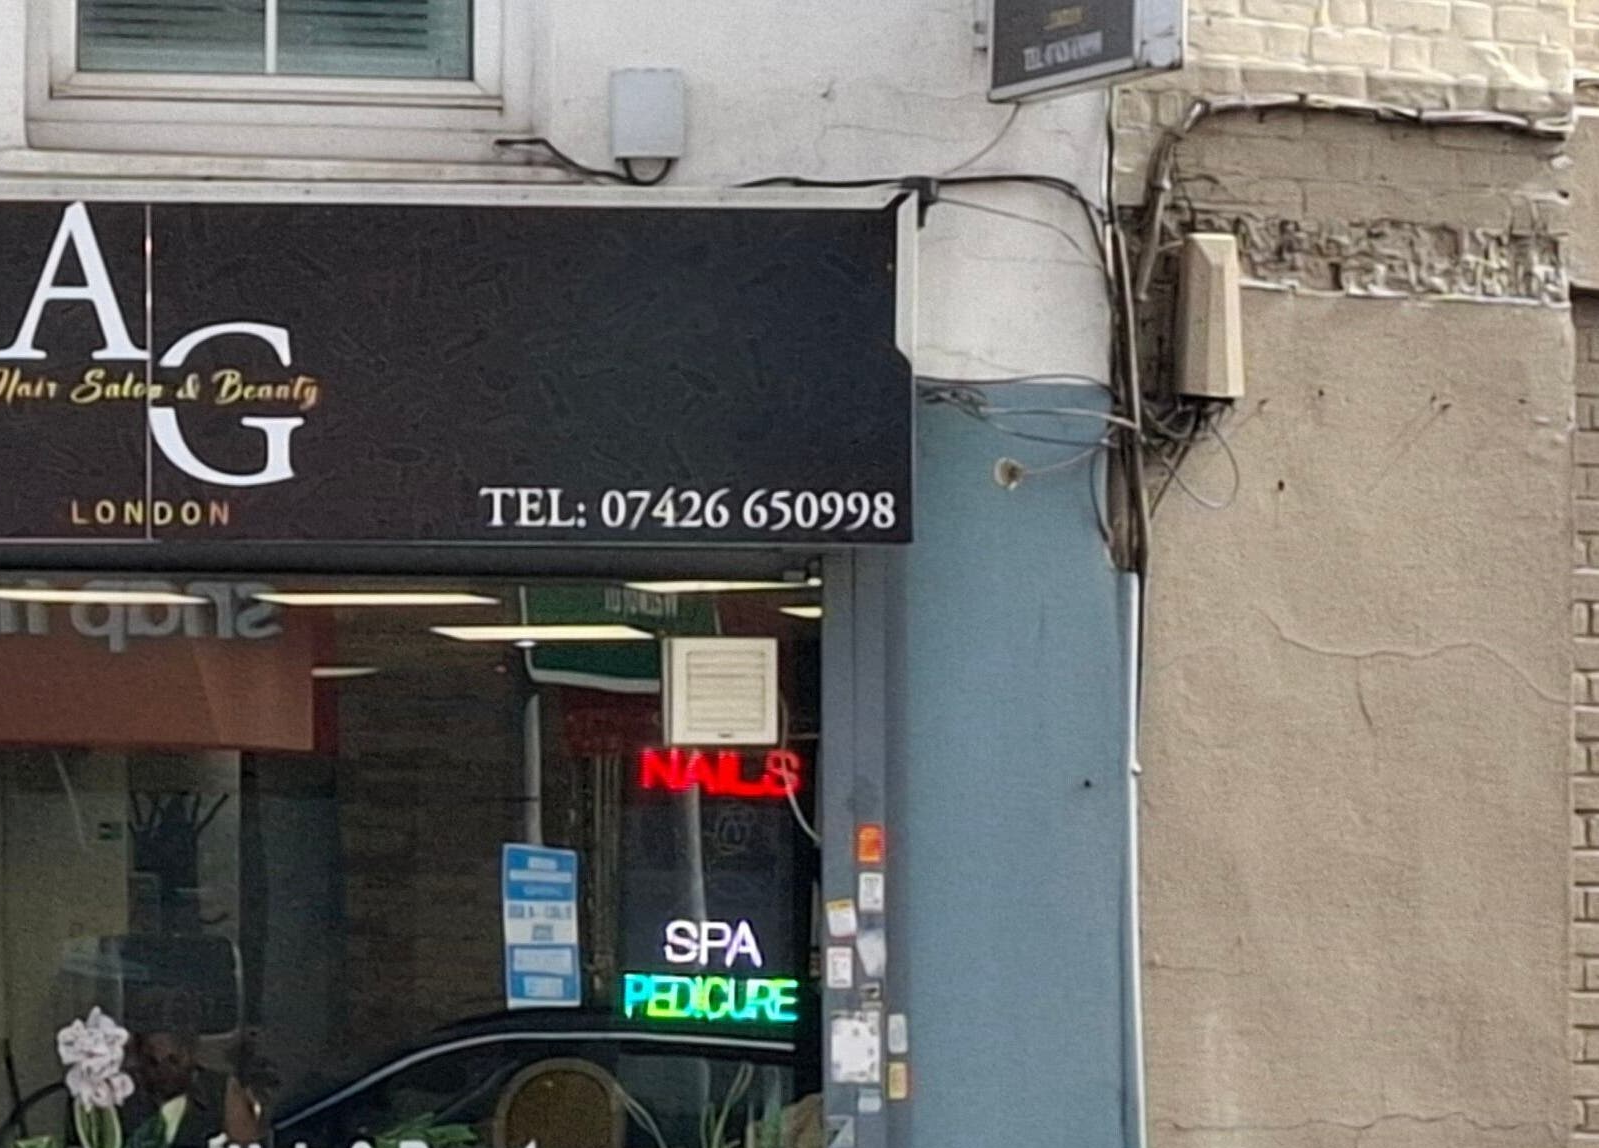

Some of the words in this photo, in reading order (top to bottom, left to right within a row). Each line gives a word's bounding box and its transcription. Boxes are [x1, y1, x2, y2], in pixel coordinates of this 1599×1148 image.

[69, 367, 163, 404] Salon
[176, 373, 200, 399] &
[211, 368, 320, 409] Beauty
[71, 499, 230, 527] LONDON
[478, 487, 588, 529] TEL:
[601, 487, 731, 530] 07426
[742, 488, 897, 531] 650998
[638, 747, 802, 797] NAILS
[663, 919, 763, 967] SPA
[623, 973, 799, 1022] PEDICURE
